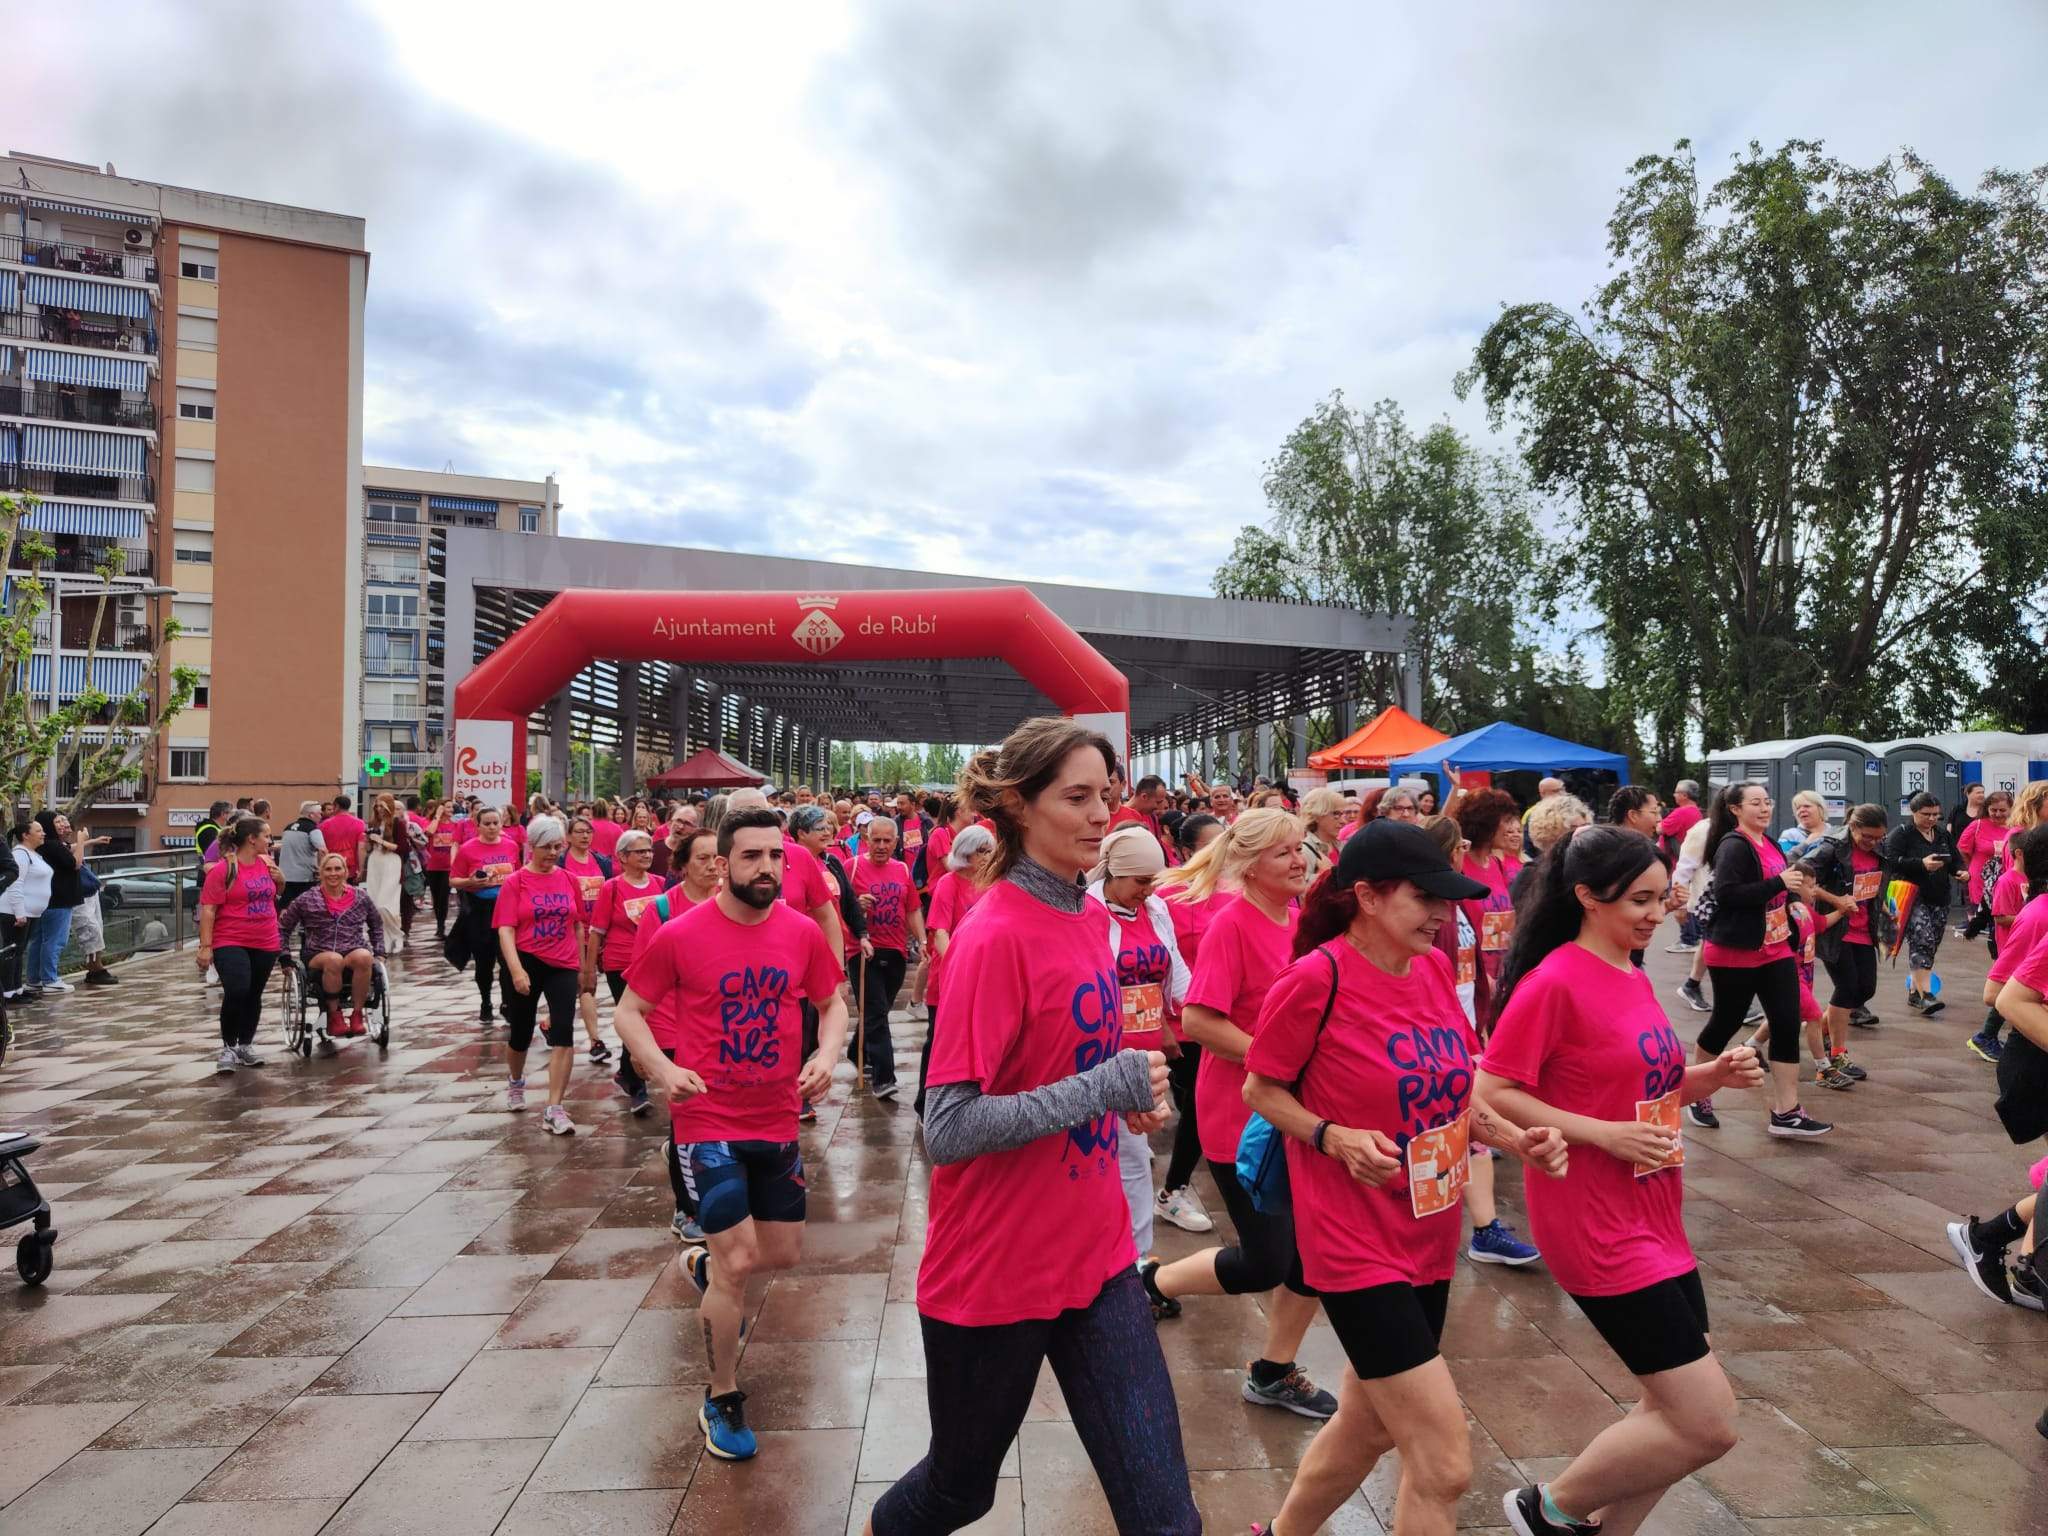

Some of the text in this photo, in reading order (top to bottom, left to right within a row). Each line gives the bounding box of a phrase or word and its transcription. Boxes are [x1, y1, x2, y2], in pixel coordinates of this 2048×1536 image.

[652, 614, 937, 641] Ajuntament de Rubí
[456, 778, 506, 792] esport
